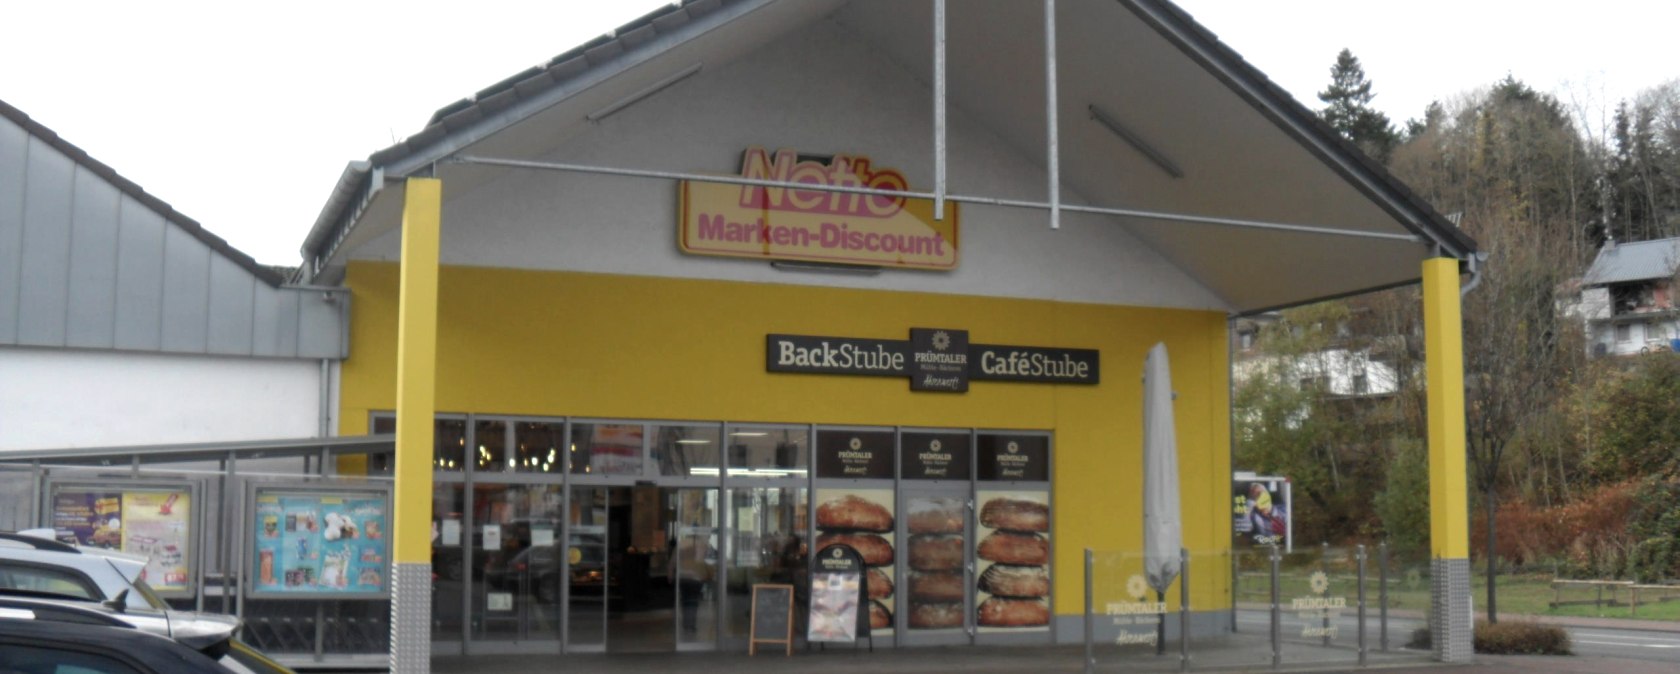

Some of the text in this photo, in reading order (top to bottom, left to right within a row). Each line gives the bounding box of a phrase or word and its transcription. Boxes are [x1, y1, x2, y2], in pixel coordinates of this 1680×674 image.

[739, 147, 908, 218] Netto
[698, 214, 945, 256] Marken-Discount
[778, 341, 904, 371] BackStube
[914, 350, 967, 364] PRÜMTALER
[981, 348, 1089, 378] CaféStube
[1106, 600, 1168, 615] PRÜMTALER
[1292, 595, 1347, 610] PRÜMTALER
